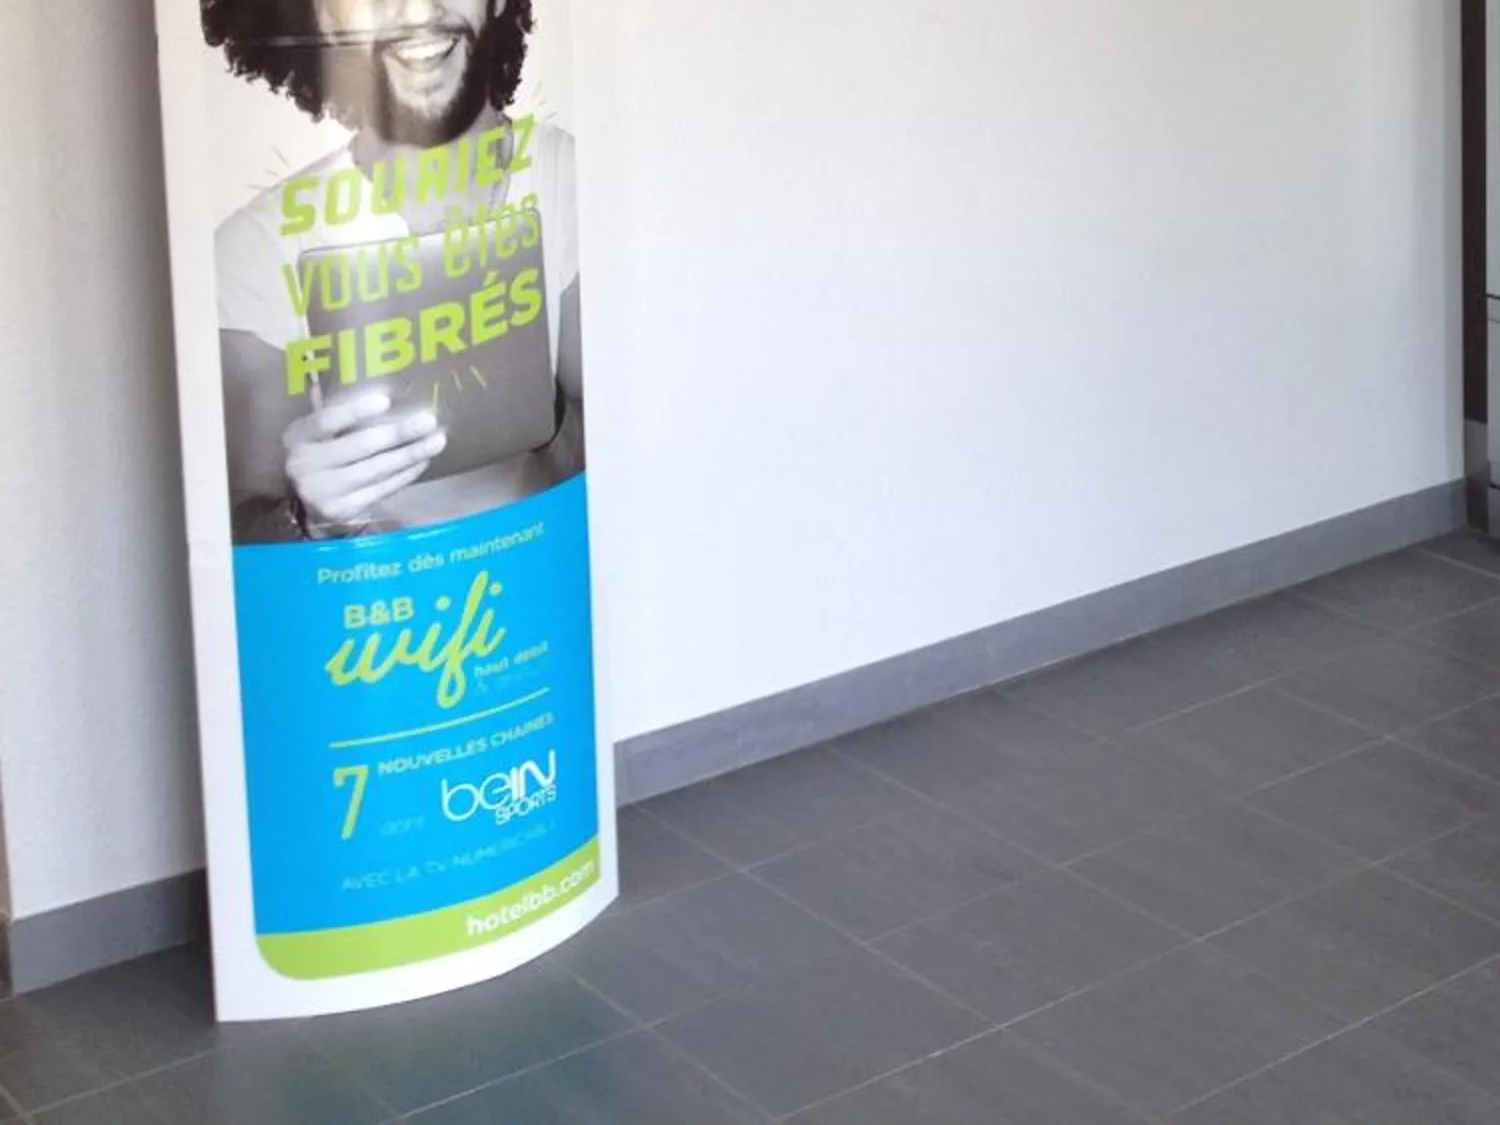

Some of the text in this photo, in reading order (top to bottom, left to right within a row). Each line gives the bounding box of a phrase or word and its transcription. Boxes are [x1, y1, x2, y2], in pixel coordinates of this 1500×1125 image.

[280, 112, 535, 237] SOURIEZ
[285, 267, 544, 396] FIBRÉS
[317, 521, 545, 585] Profitez dès maintenant
[324, 571, 506, 709] wifi
[344, 596, 414, 629] B&B
[377, 737, 488, 775] NOUVELLES
[332, 764, 369, 840] 7
[495, 784, 557, 826] SPORTS
[465, 857, 595, 937] hotelbb.com
